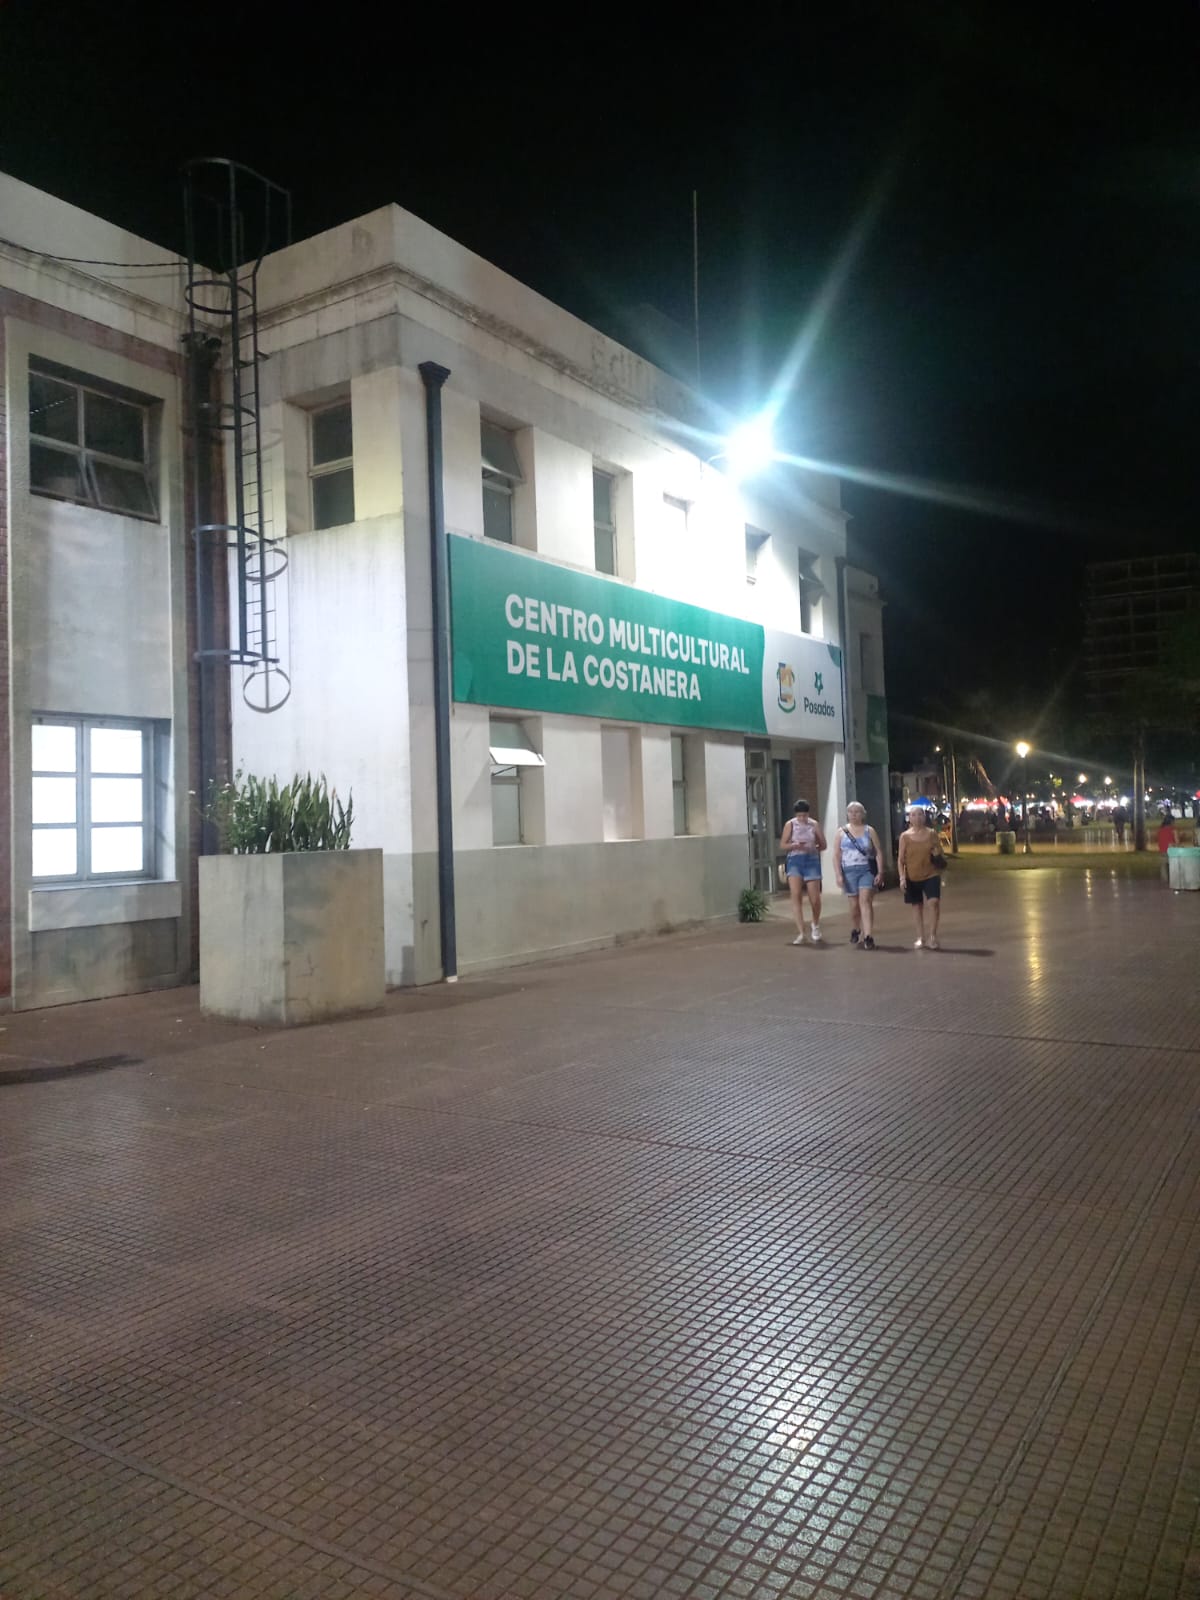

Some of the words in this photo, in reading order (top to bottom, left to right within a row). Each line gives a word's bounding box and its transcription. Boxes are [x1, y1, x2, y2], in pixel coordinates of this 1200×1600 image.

[505, 593, 604, 645] CENTRO
[609, 619, 749, 674] MULTICULTURAL
[506, 640, 541, 678] DE
[547, 649, 578, 684] LA
[583, 656, 702, 701] COSTANERA
[803, 697, 835, 717] Posadas
